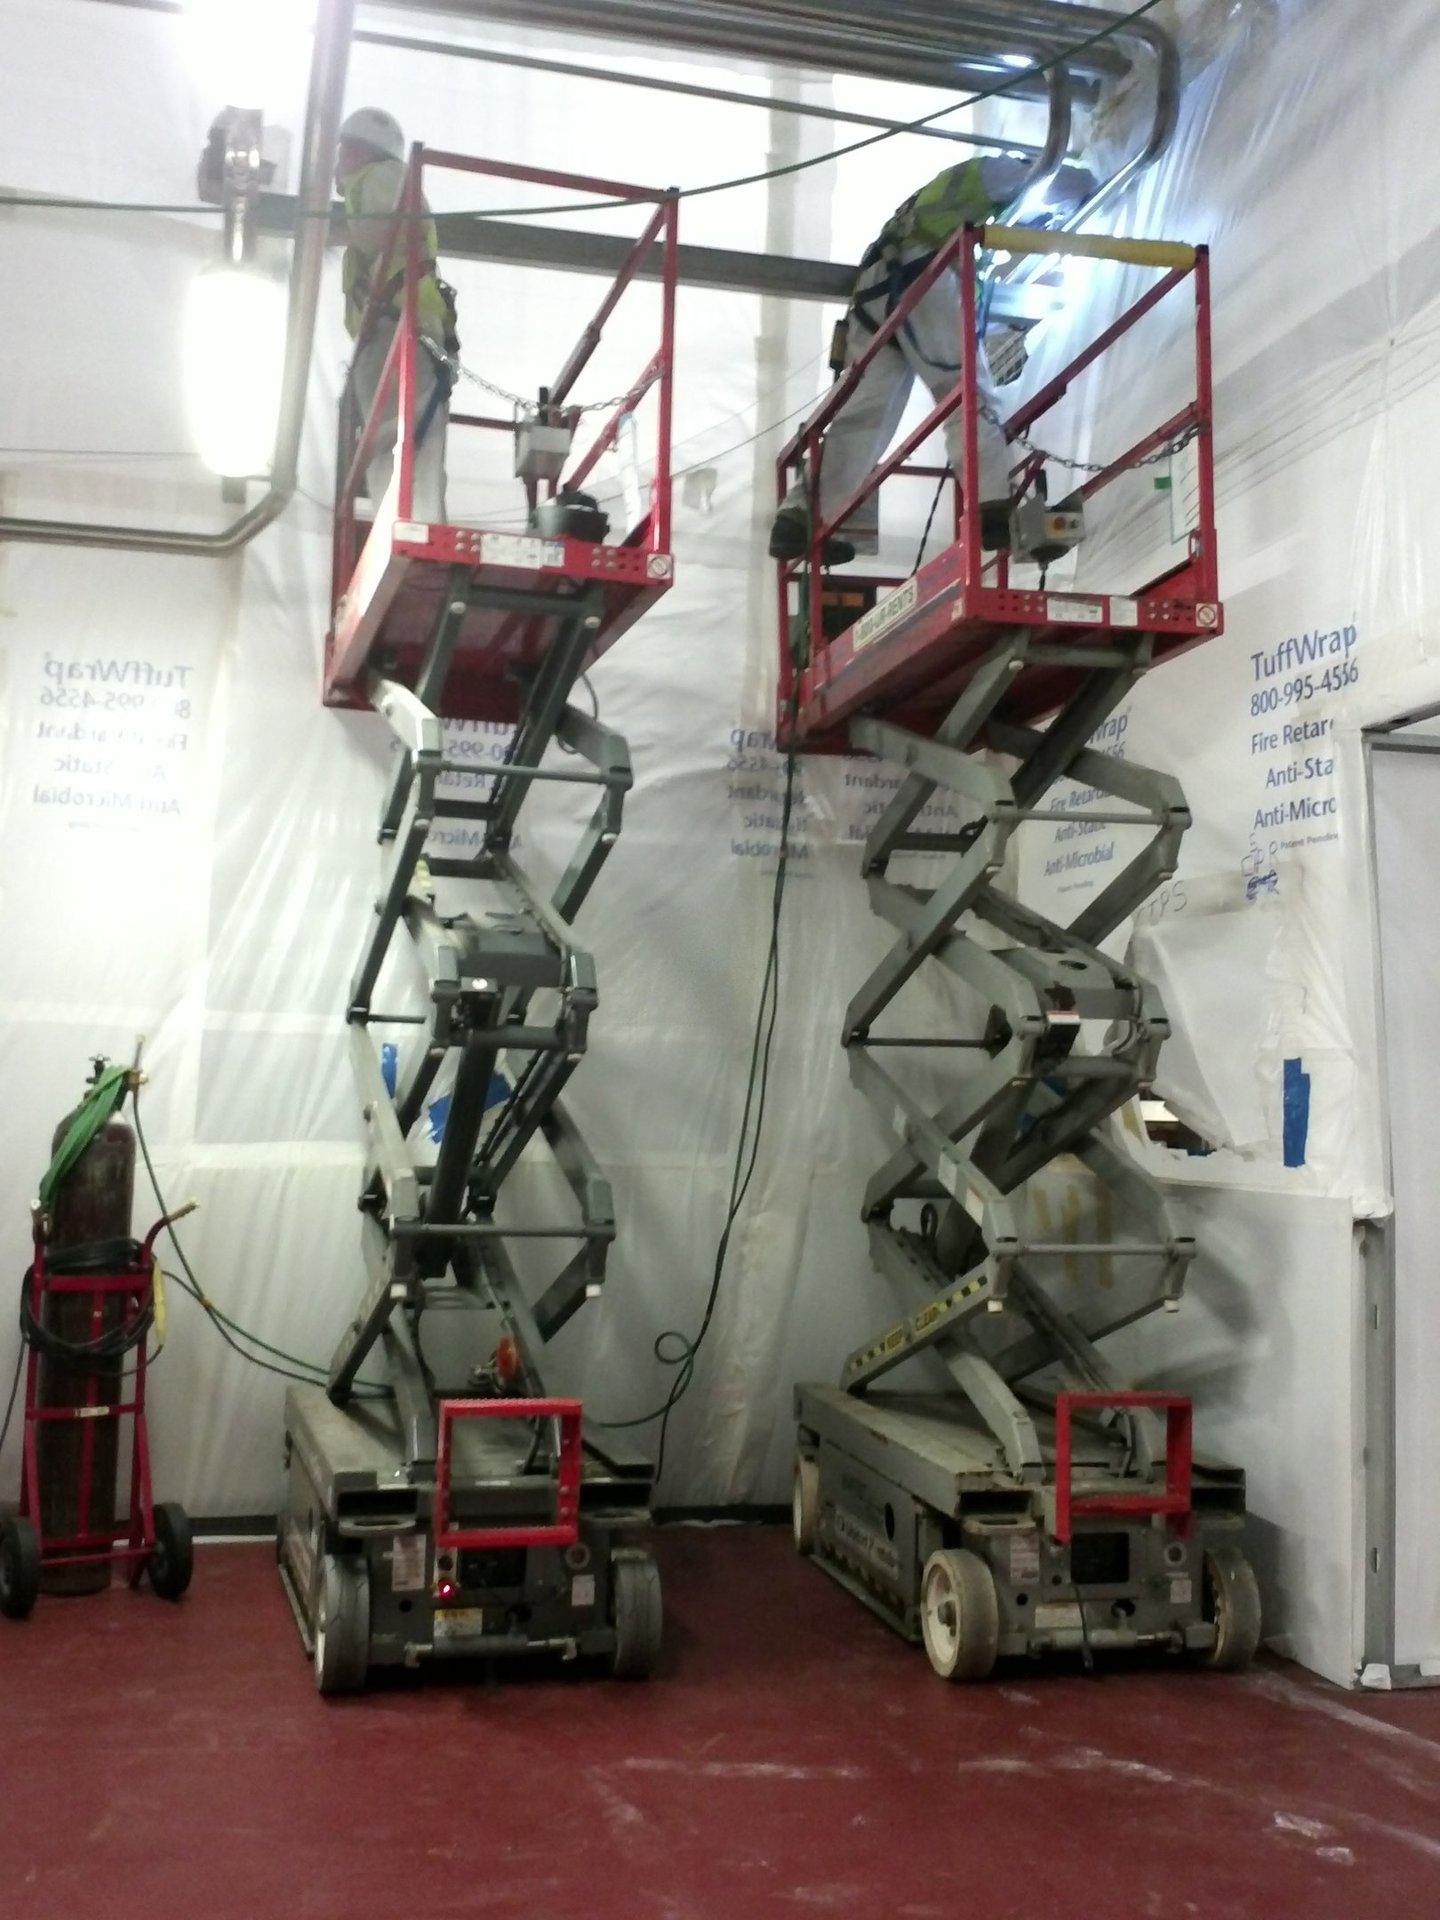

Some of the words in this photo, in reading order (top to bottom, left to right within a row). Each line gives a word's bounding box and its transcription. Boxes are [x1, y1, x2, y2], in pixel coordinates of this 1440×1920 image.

[1250, 621, 1358, 682] TuffWrap
[1250, 658, 1360, 717] 800-995-4556
[1251, 732, 1279, 755] Fire
